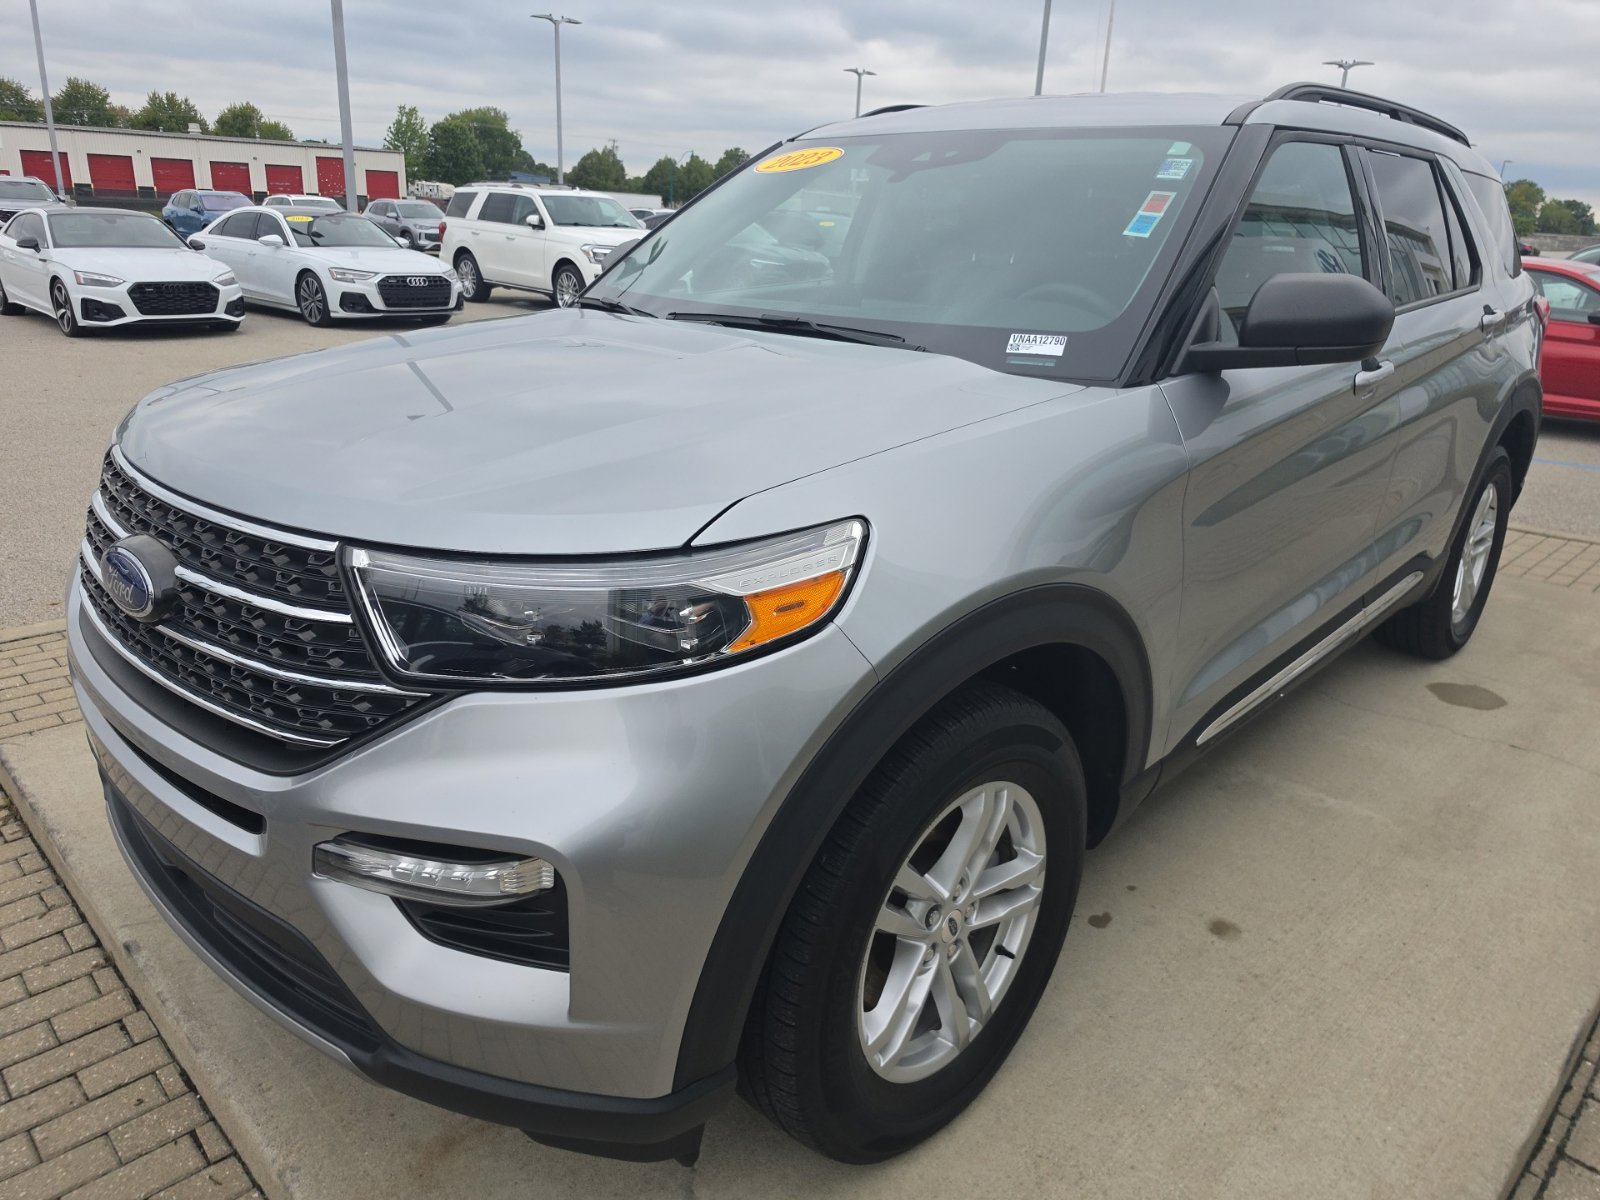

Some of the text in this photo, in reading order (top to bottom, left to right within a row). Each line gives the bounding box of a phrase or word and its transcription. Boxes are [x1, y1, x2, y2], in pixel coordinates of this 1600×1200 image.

[764, 151, 834, 169] 2023
[1012, 334, 1066, 345] VNAA12790
[740, 556, 837, 587] EXPLORER
[107, 565, 134, 604] Ford
